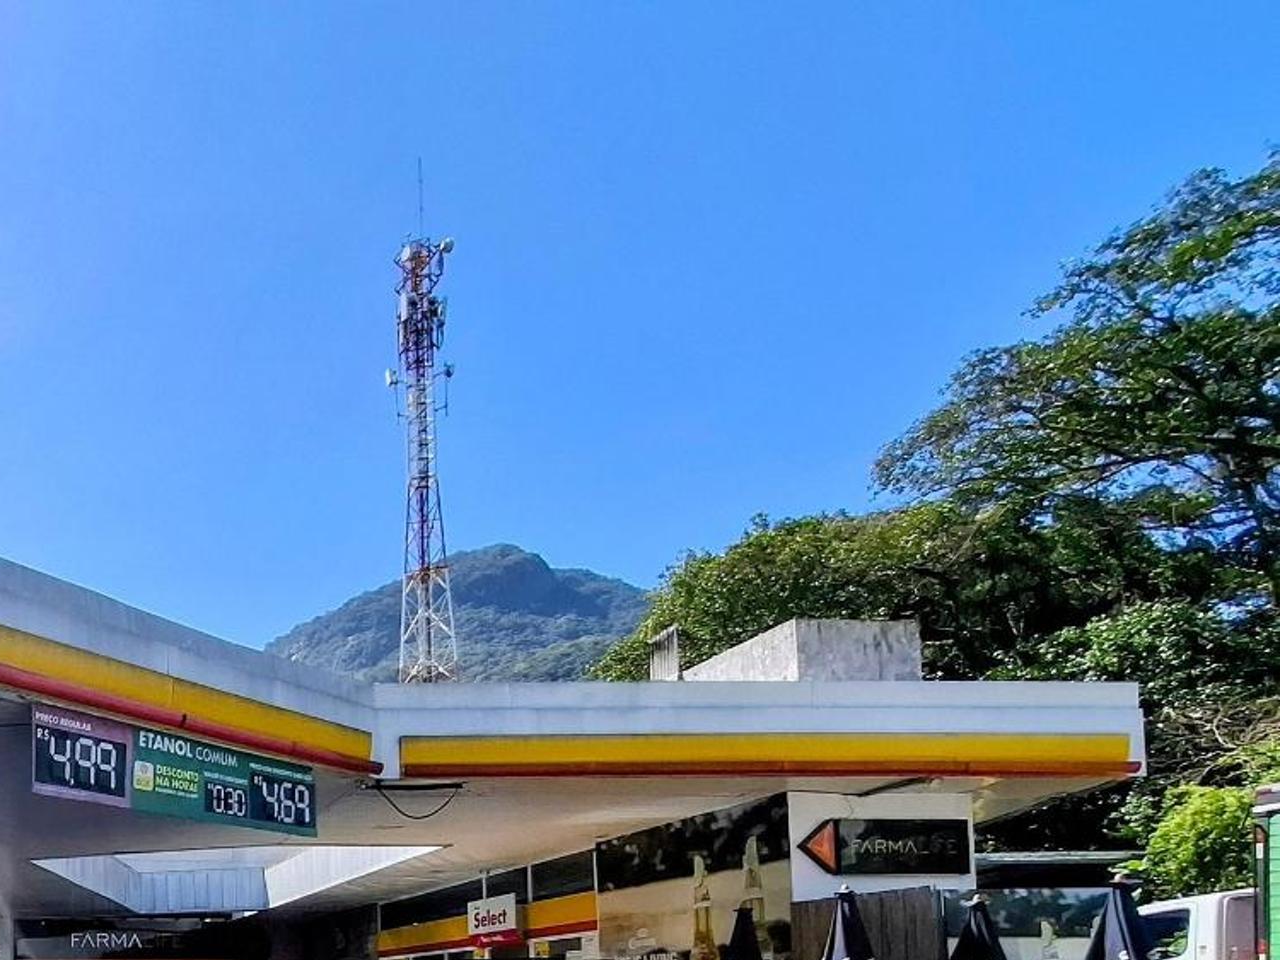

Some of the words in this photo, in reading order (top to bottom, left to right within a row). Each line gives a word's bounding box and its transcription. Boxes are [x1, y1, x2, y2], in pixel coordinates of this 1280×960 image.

[139, 730, 193, 758] ETANOL
[195, 746, 238, 767] COMUM
[474, 908, 507, 929] Select
